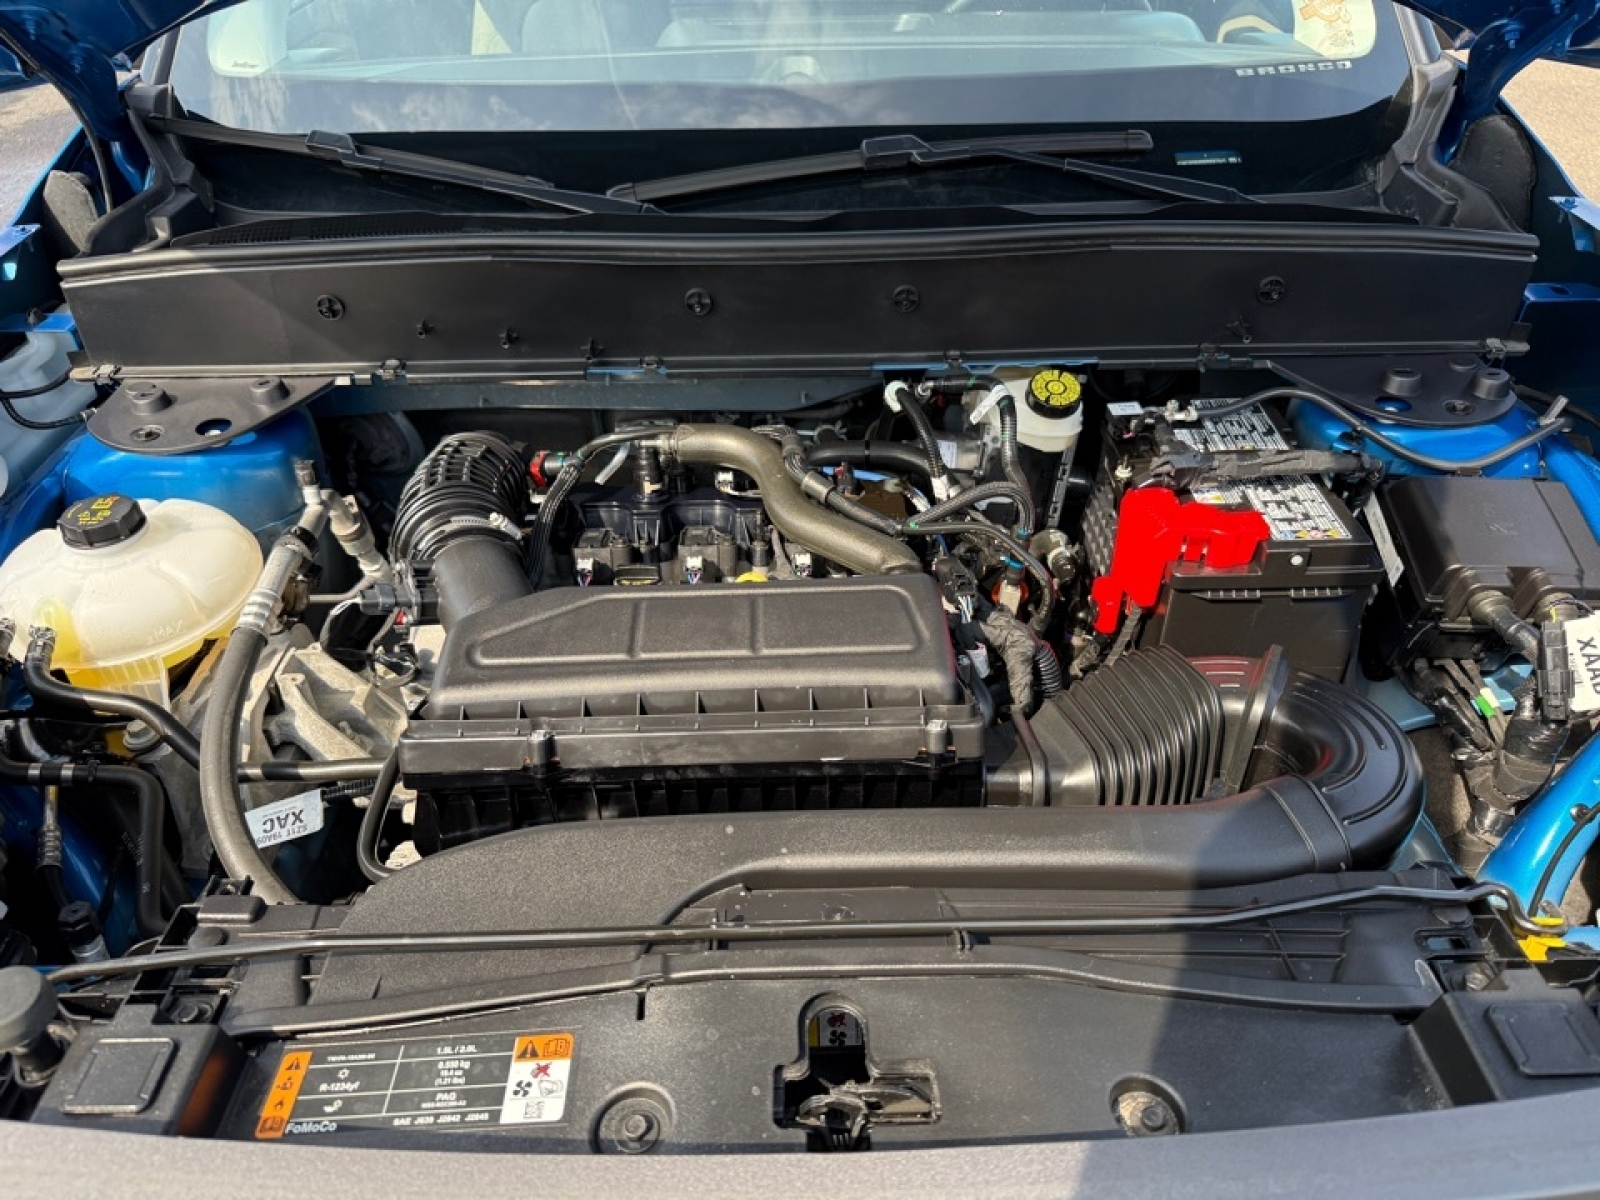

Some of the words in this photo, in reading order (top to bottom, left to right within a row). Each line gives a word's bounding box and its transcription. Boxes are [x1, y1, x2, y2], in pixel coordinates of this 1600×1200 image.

[1235, 60, 1352, 77] BRONCO
[262, 809, 304, 834] XAC
[318, 1081, 360, 1092] R-1234yf
[285, 1120, 338, 1134] FoMoCo
